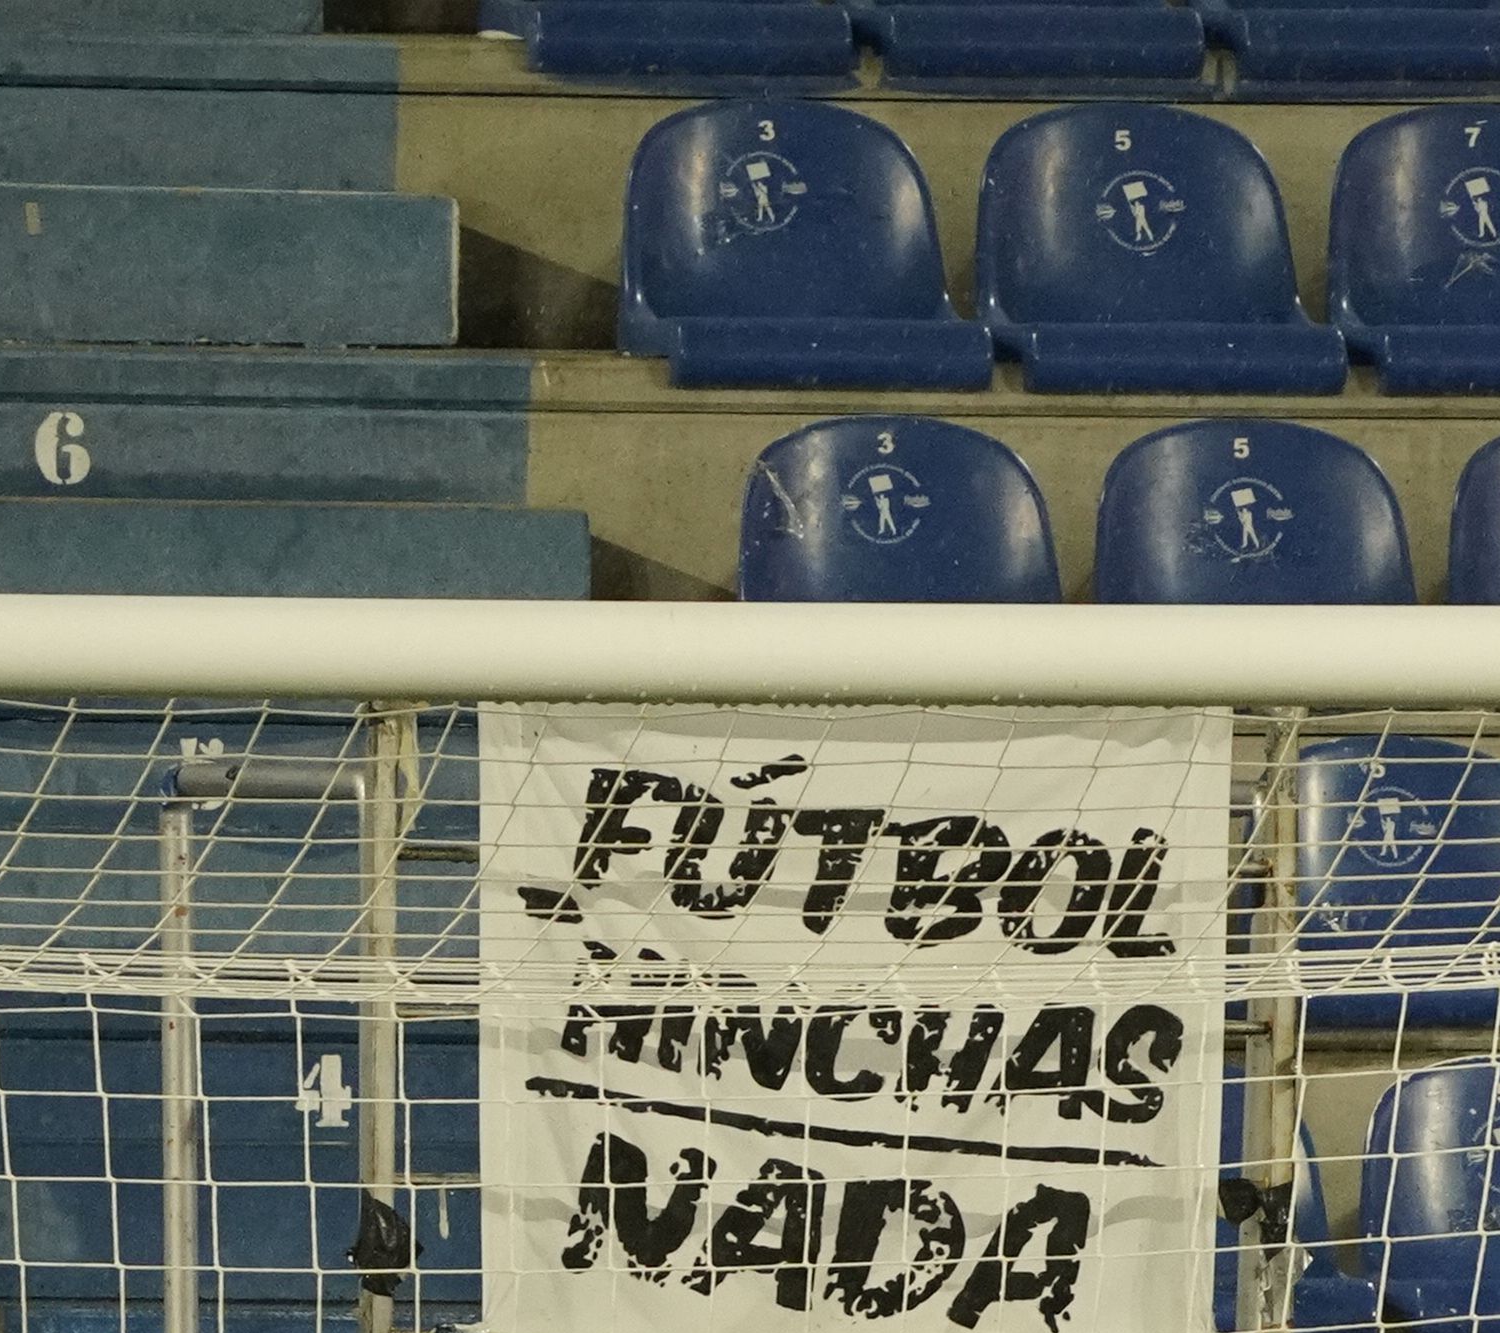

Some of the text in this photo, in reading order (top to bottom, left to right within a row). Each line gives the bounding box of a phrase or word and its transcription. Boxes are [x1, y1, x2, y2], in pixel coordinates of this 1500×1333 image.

[758, 119, 776, 141] 3
[1114, 129, 1132, 151] 5
[1464, 126, 1481, 148] 7
[34, 411, 91, 485] 6
[877, 431, 895, 455] 3
[1233, 437, 1250, 459] 5
[571, 754, 1177, 956] FÚTBOL
[561, 940, 1185, 1124] HINCHAS
[295, 1054, 352, 1127] 4
[561, 1130, 1090, 1333] NADA
